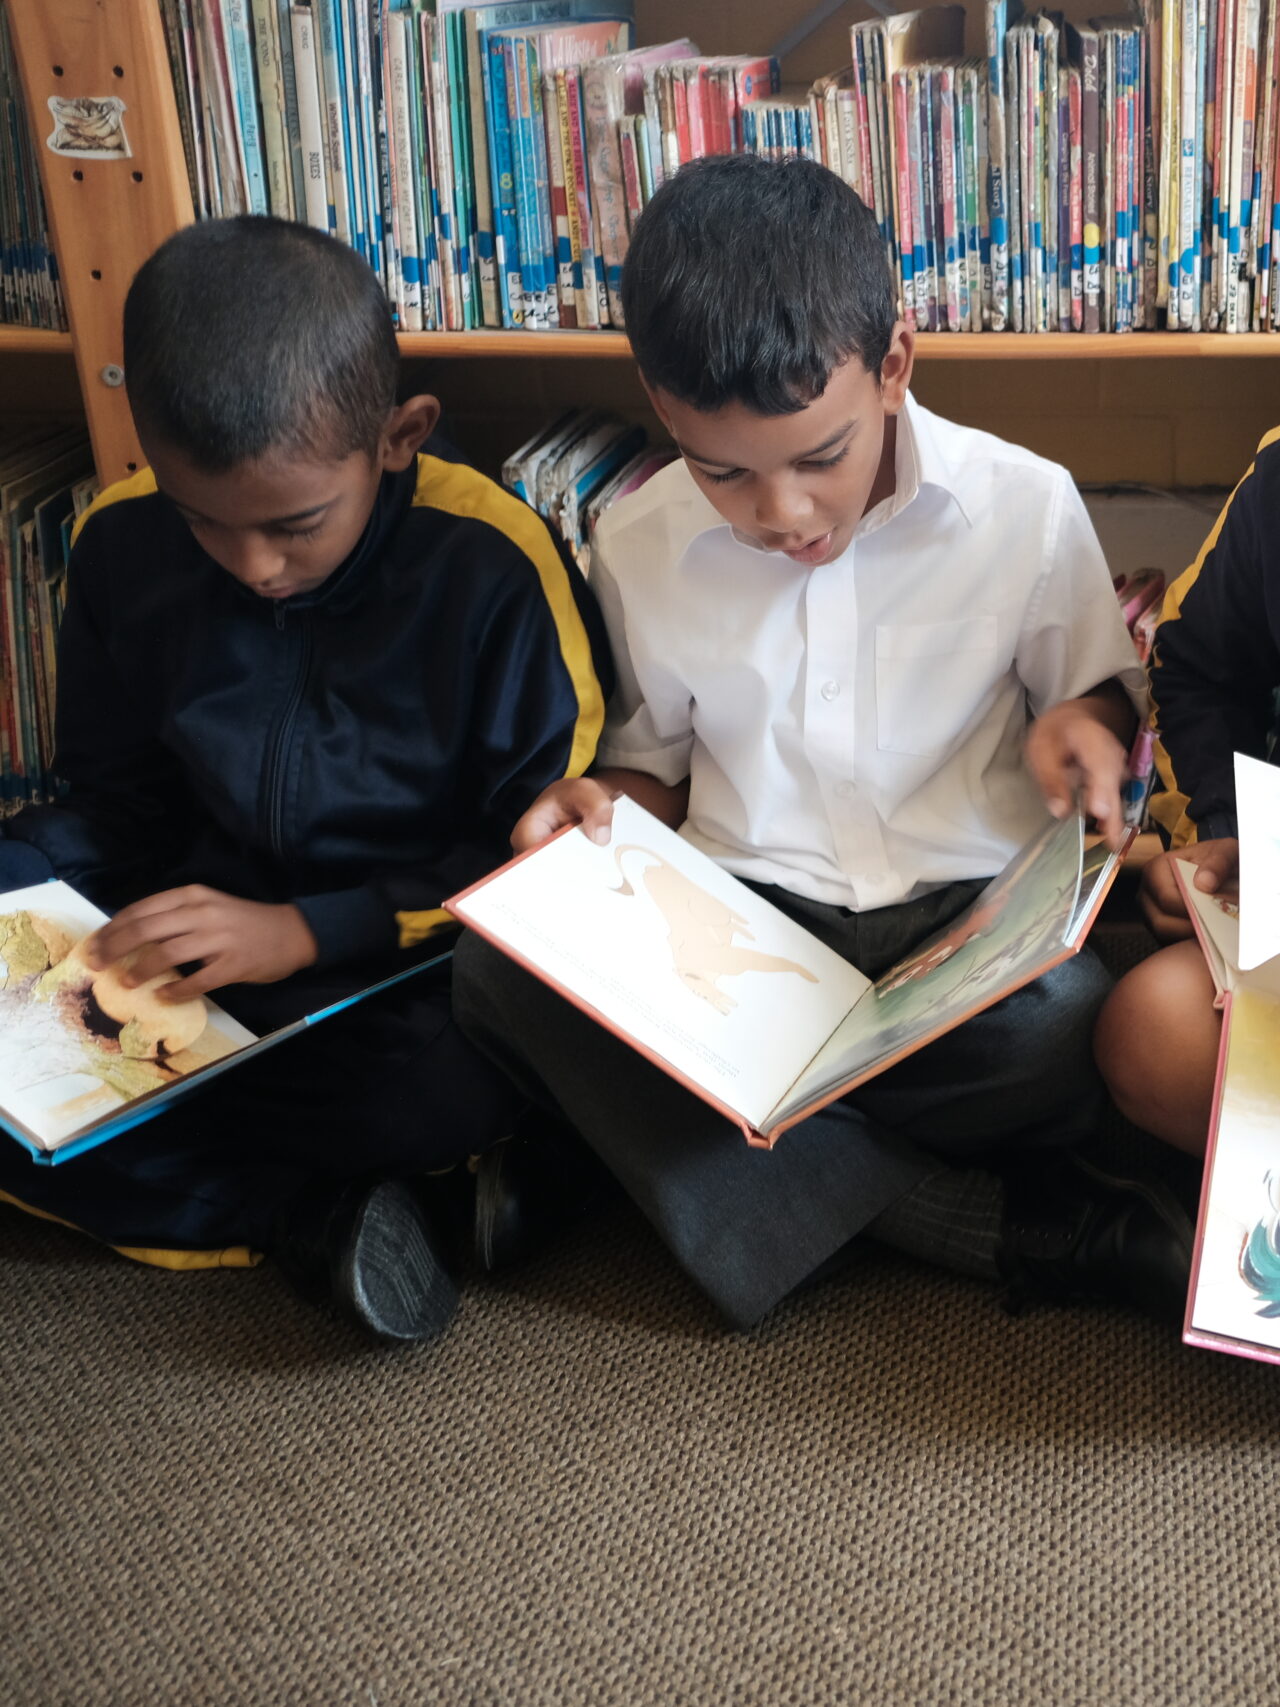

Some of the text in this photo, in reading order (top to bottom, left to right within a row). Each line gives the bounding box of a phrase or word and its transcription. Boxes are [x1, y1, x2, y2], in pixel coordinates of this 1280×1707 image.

[394, 58, 403, 92] CARLE
[328, 102, 339, 138] Whiffle
[396, 107, 406, 134] HAVE
[560, 110, 568, 126] AND
[246, 124, 256, 147] Party
[568, 84, 584, 186] ALBIE AND THE BIG RACE
[1084, 54, 1098, 214] Dolch Animal Stories
[310, 152, 320, 180] BOXES
[399, 154, 408, 182] SEEN
[562, 148, 571, 172] SPACE
[564, 176, 573, 202] ROCKET
[992, 179, 1003, 209] Story
[1145, 176, 1154, 208] Story
[572, 220, 580, 240] ANDY
